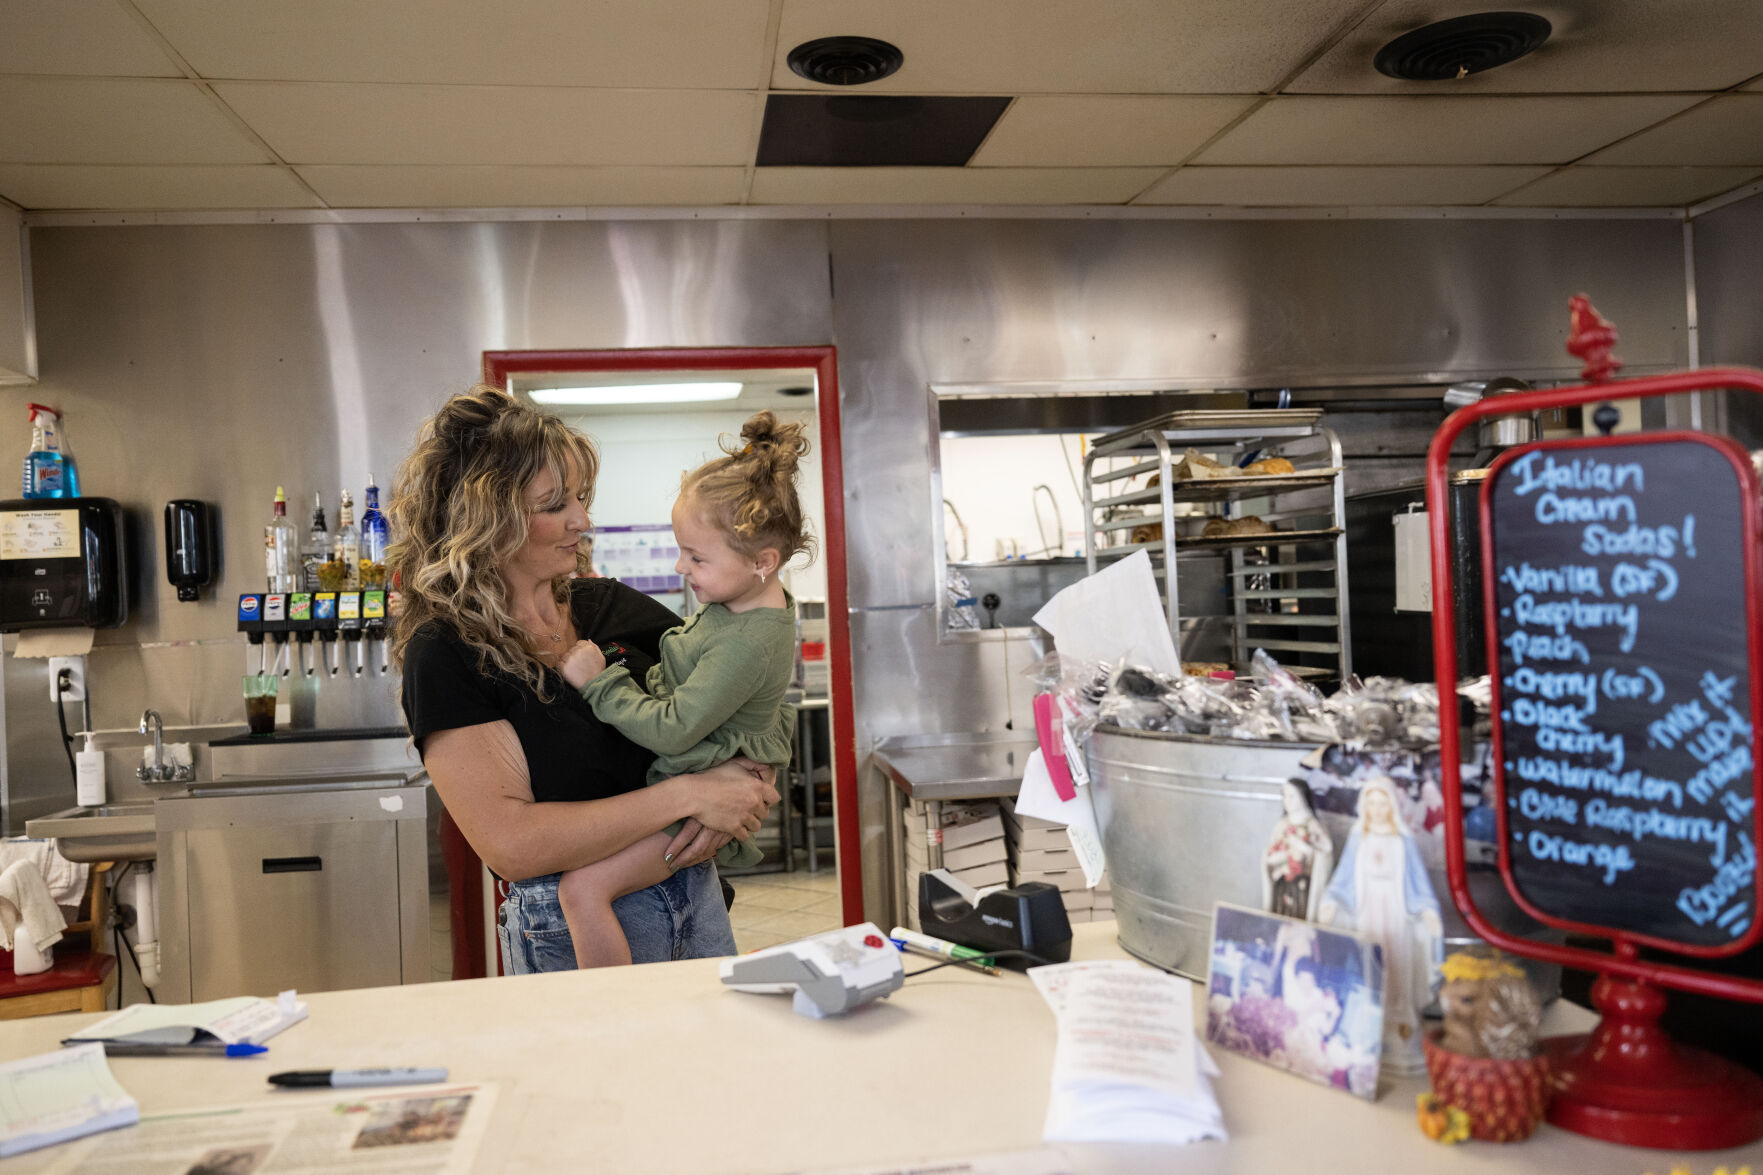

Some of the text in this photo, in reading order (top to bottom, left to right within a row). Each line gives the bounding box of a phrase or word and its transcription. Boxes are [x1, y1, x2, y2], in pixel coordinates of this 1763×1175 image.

[1511, 449, 1644, 496] Italian
[1535, 491, 1638, 525] Cream
[1581, 513, 1697, 559] Sodas!
[1505, 561, 1604, 598] Vanilla
[1527, 829, 1636, 886] Orange
